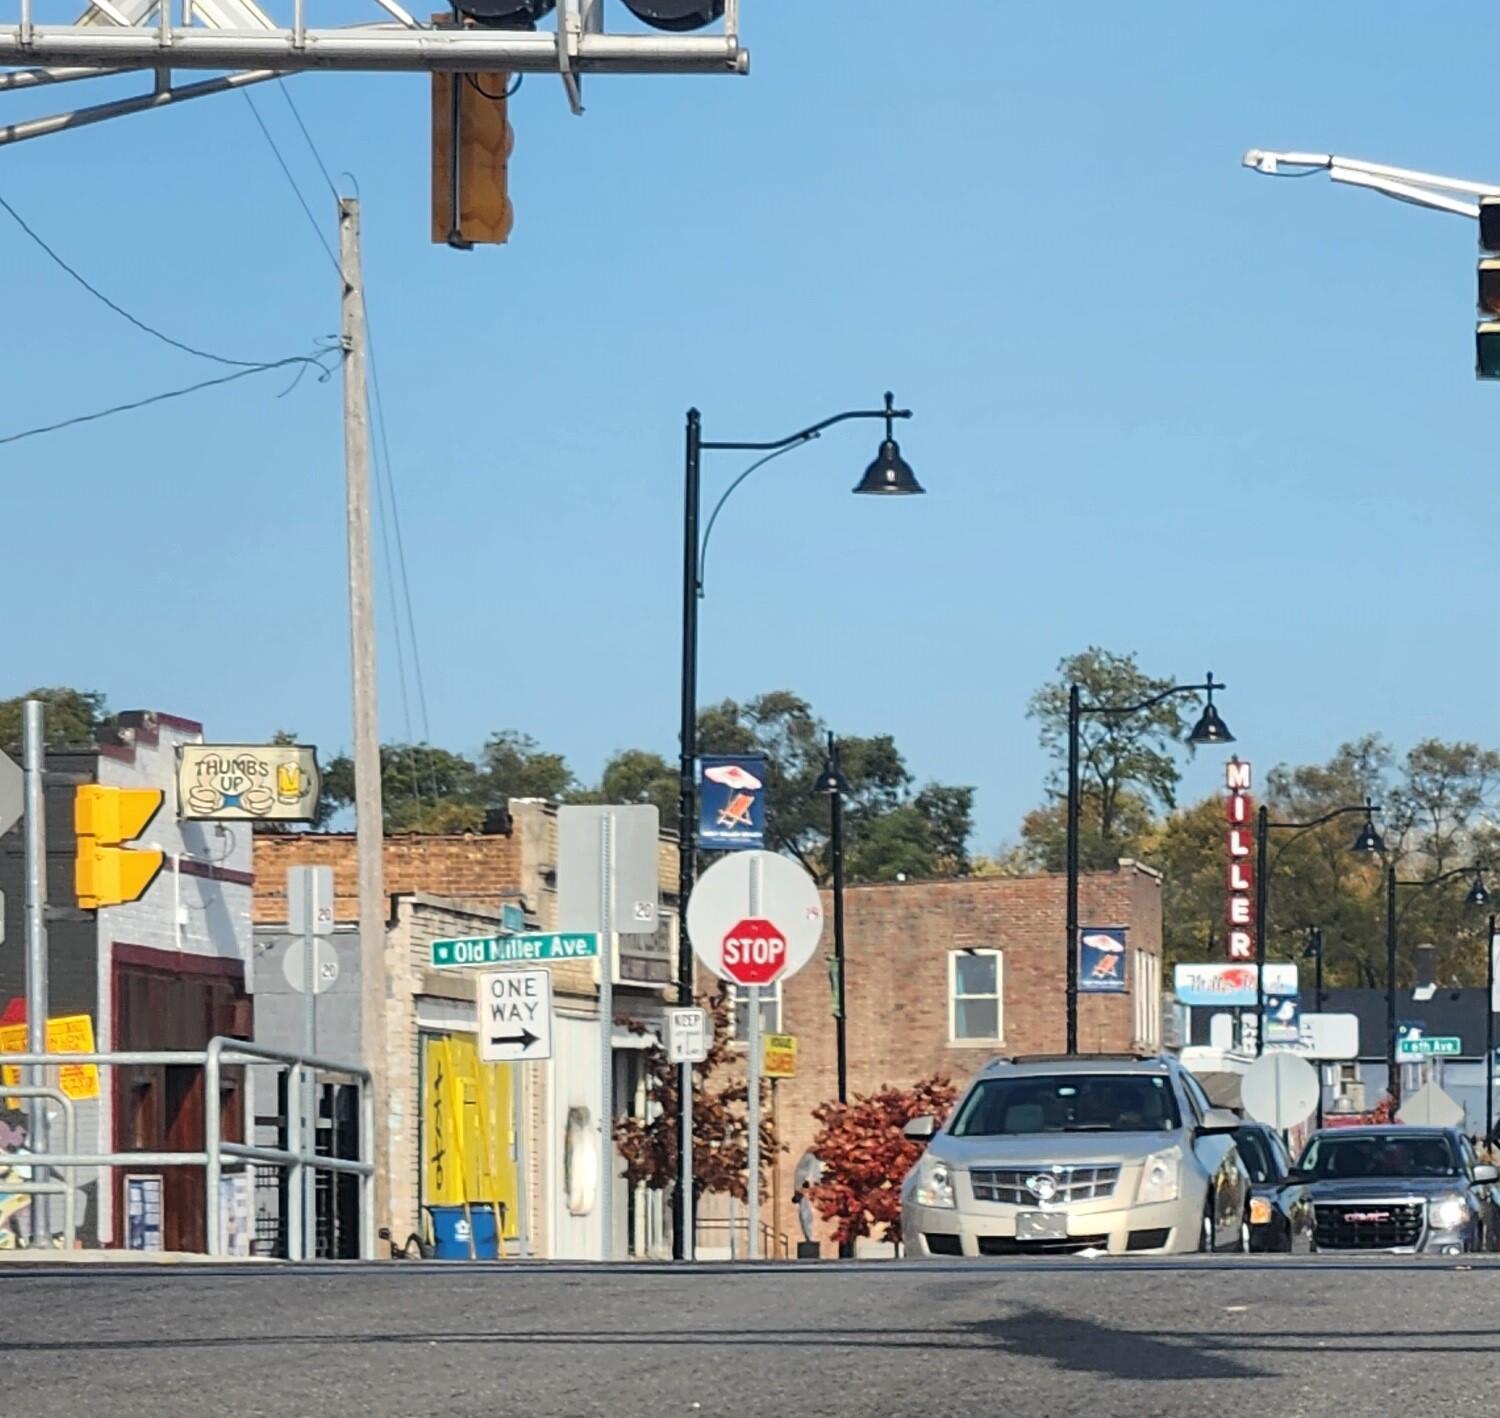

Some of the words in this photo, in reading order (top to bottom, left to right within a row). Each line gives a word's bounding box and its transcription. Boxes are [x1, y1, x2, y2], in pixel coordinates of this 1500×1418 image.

[195, 759, 269, 777] THUMBS
[220, 776, 243, 791] UP
[1227, 763, 1251, 957] MILLER
[453, 942, 485, 962] Old
[489, 938, 544, 961] Miller
[551, 936, 593, 957] Ave.
[723, 938, 785, 965] STOP
[491, 978, 537, 999] ONE
[491, 1002, 539, 1022] WAY
